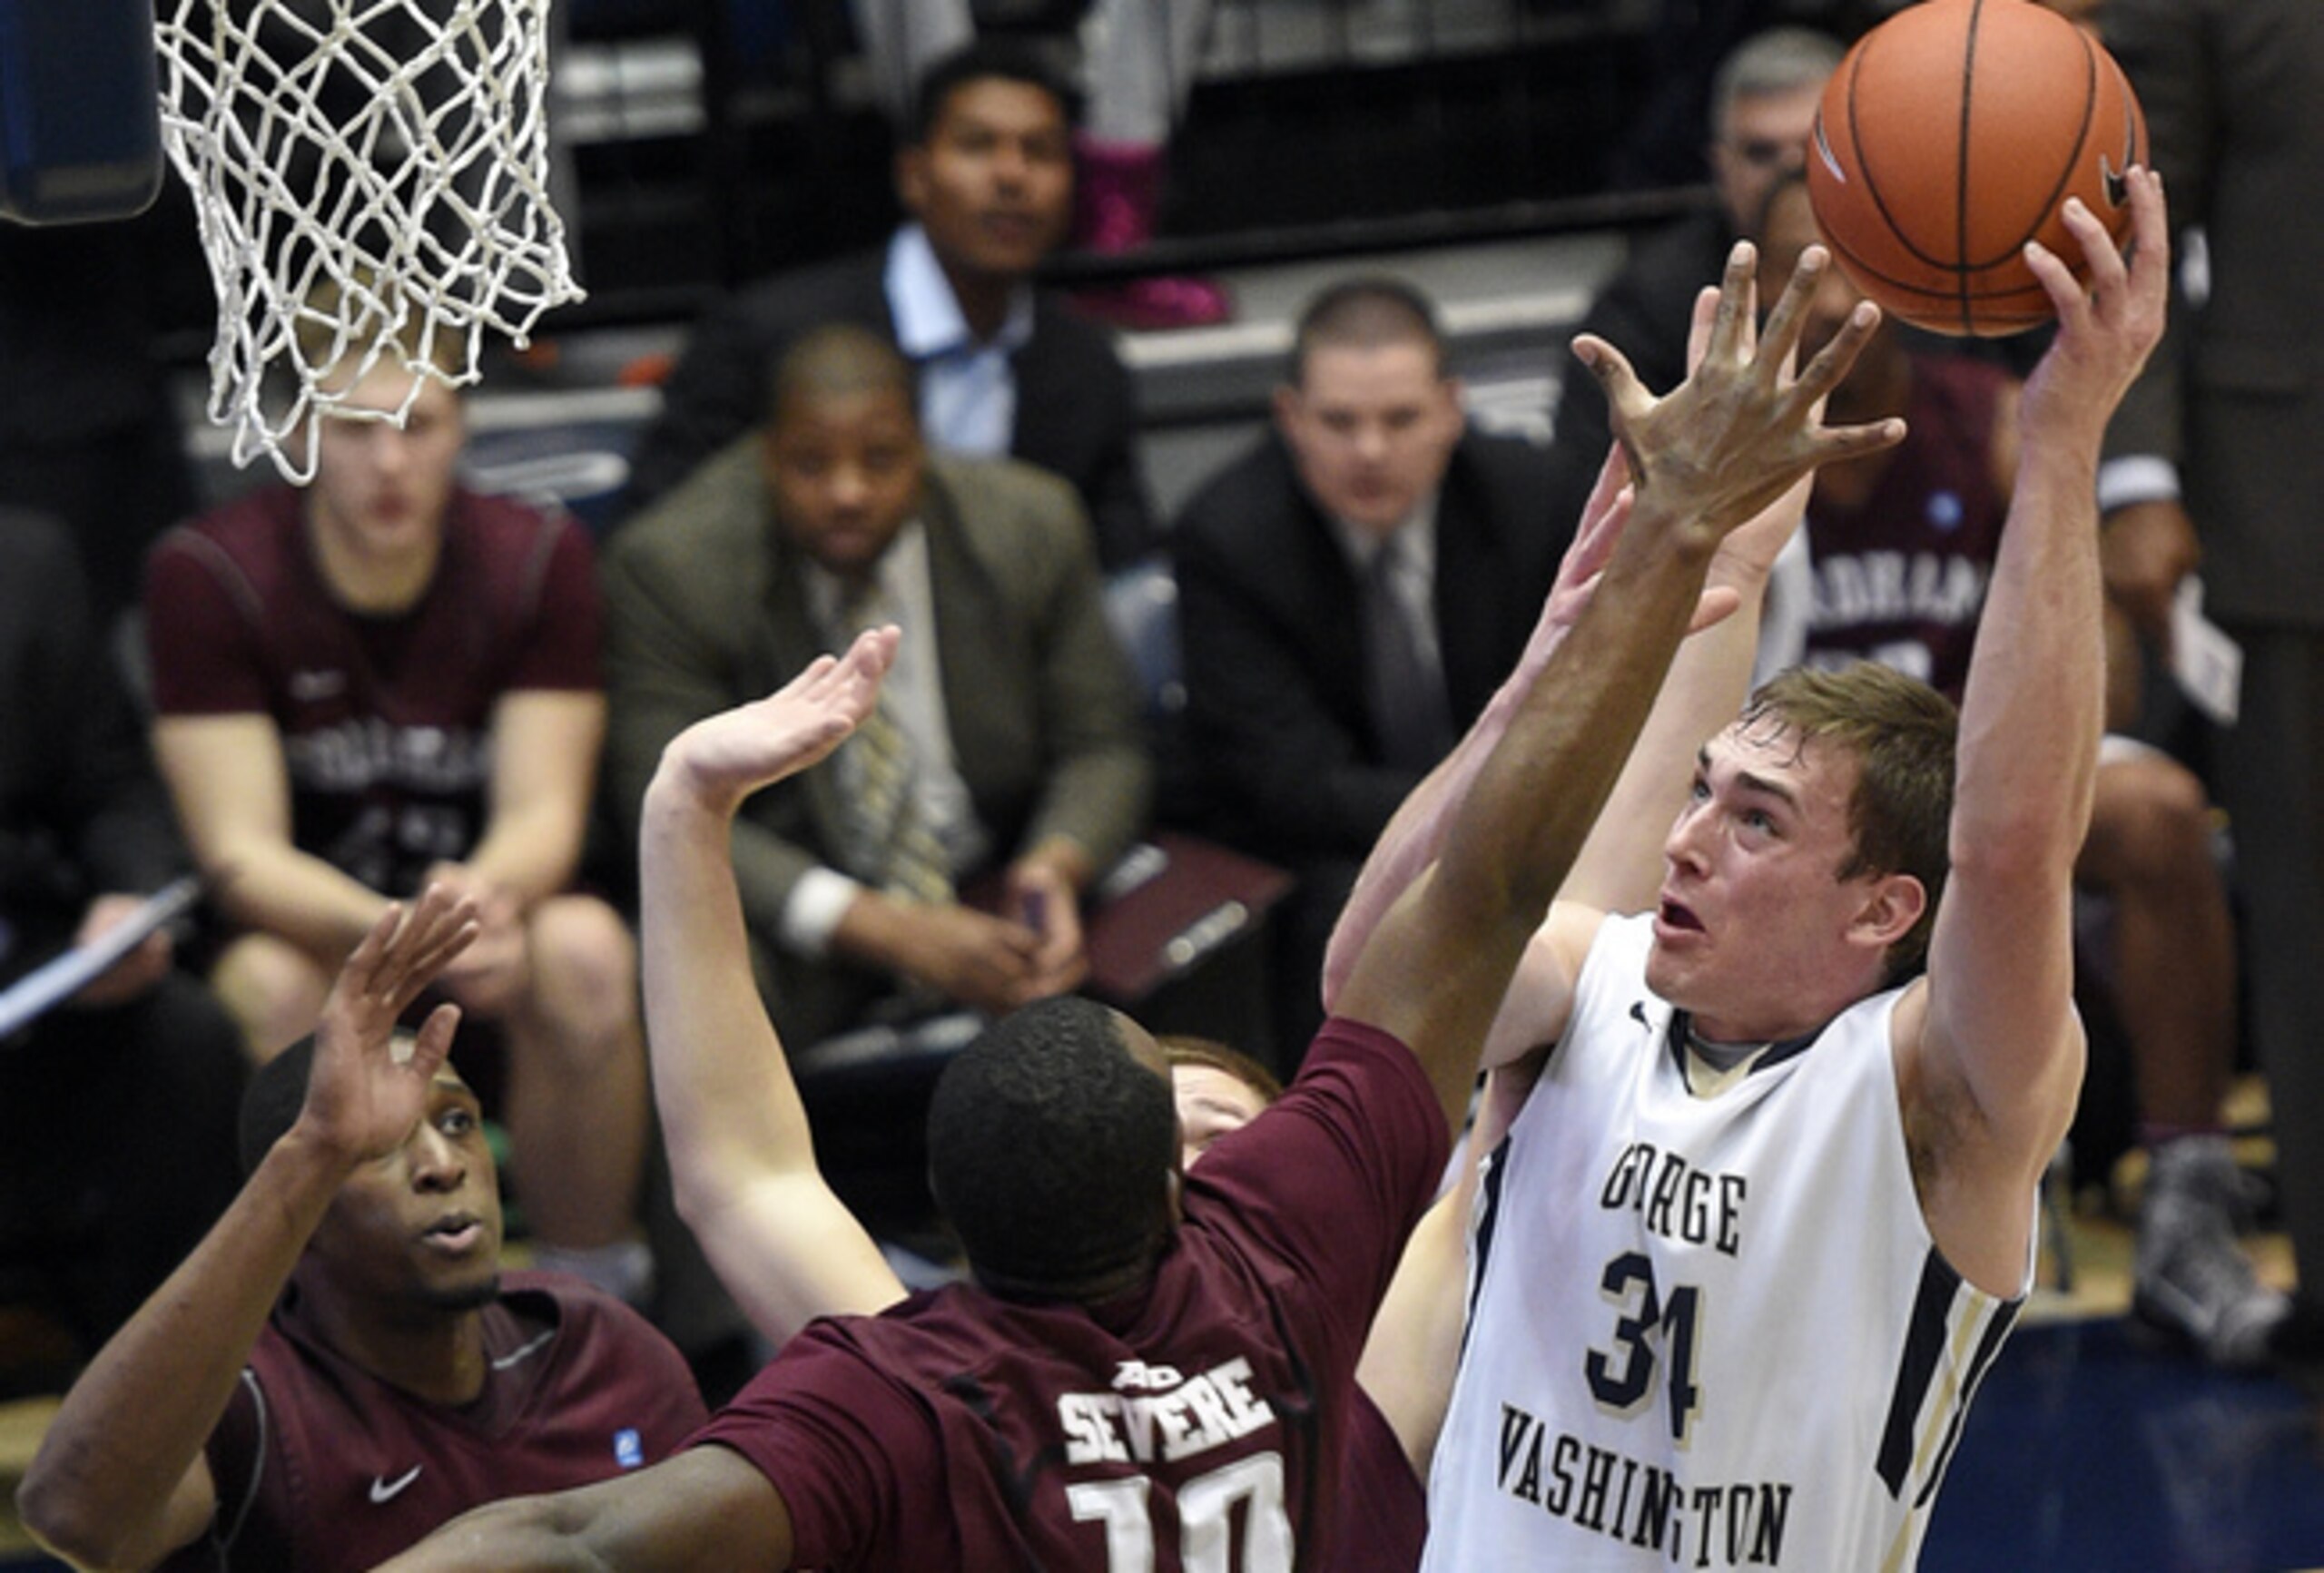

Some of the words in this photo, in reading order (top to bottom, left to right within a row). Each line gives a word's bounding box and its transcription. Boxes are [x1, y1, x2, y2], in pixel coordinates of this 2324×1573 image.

[1600, 1143, 1747, 1258] GORGE
[1058, 1356, 1275, 1464] SEVERE
[1584, 1250, 1706, 1452] 34
[1065, 1450, 1295, 1573] 10
